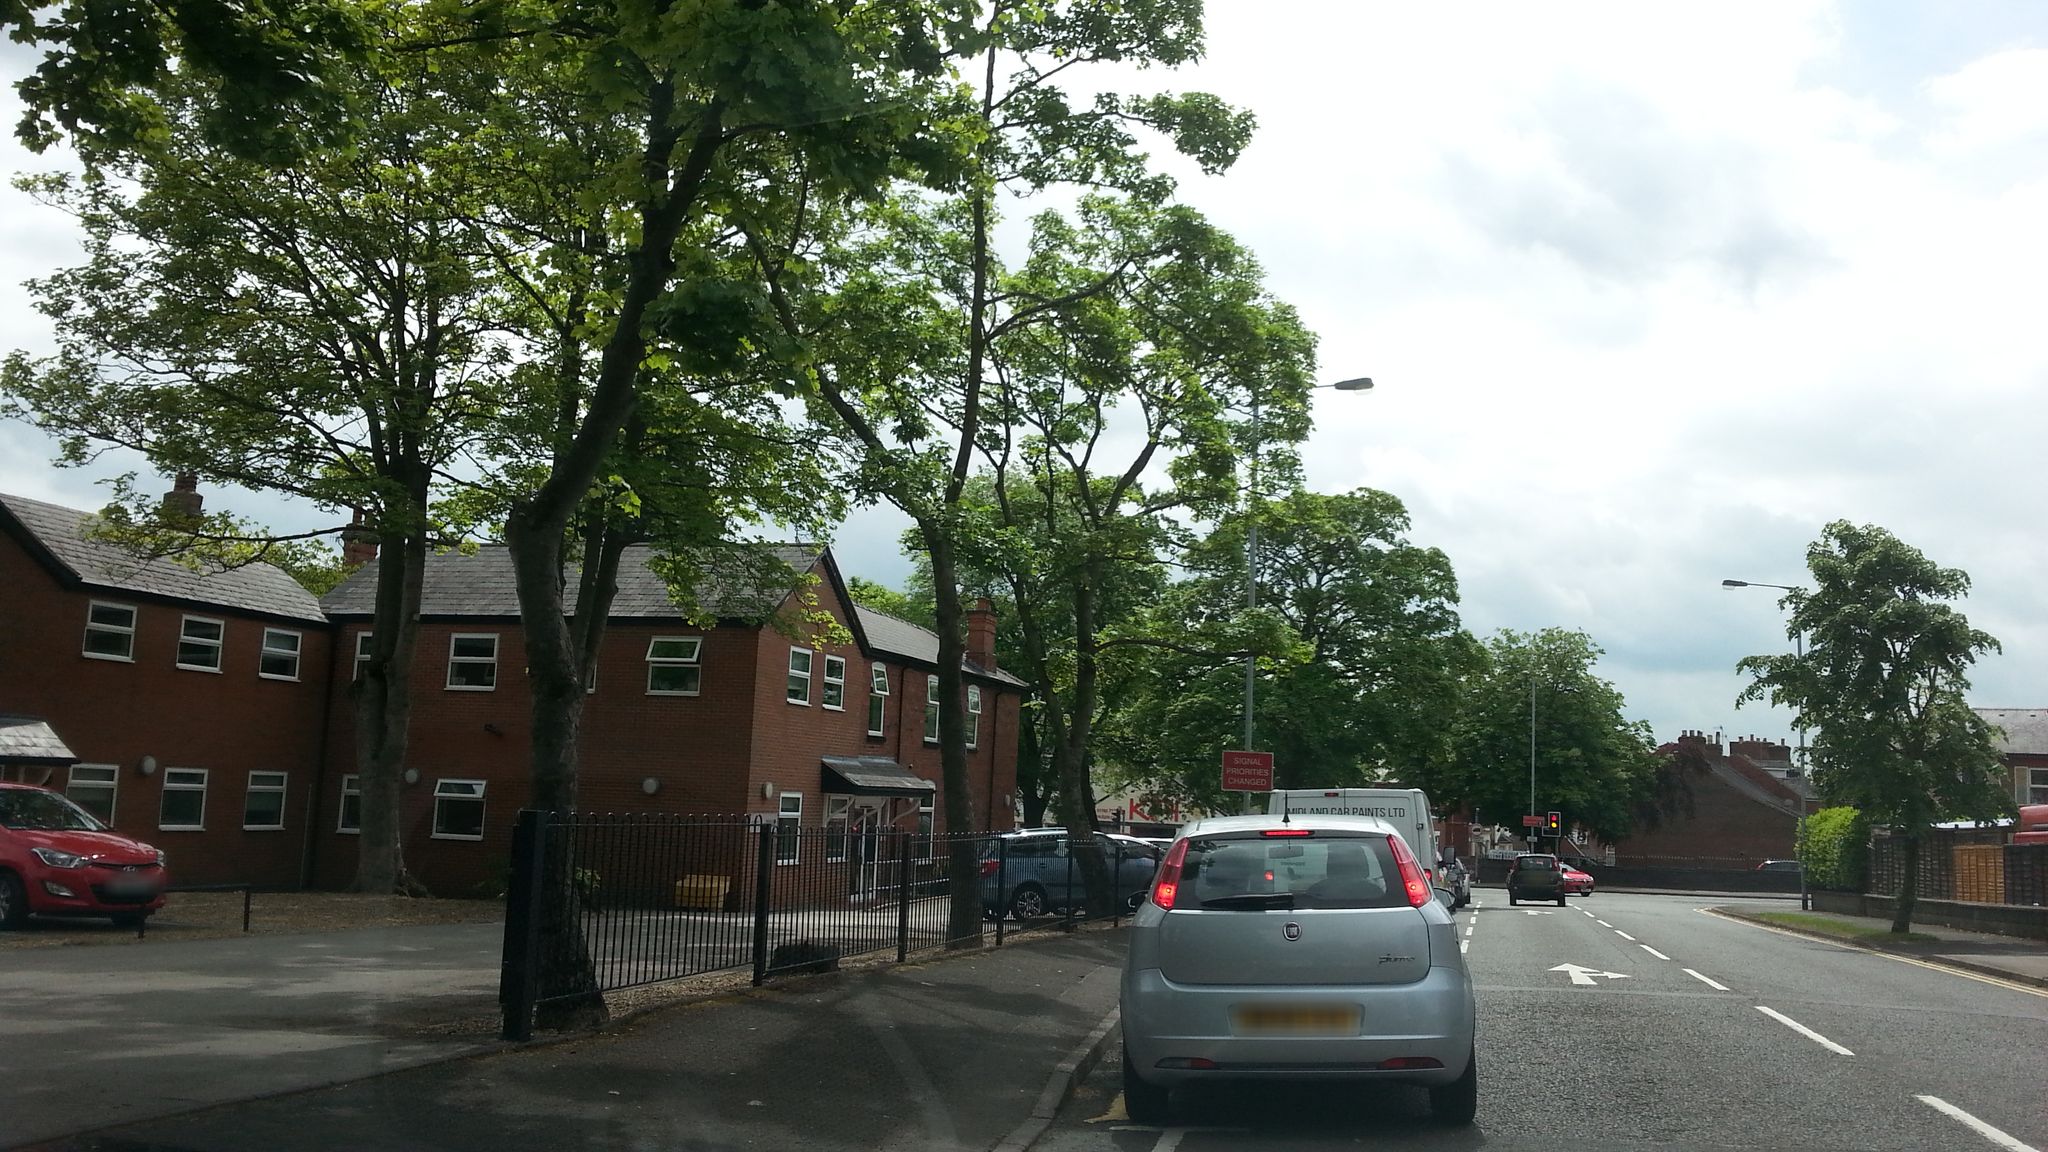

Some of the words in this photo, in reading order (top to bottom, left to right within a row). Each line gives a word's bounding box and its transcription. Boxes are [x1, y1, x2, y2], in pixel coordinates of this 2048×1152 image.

[1233, 757, 1264, 766] SIGNAL
[1226, 767, 1269, 777] PRIORITIES
[1228, 777, 1267, 786] CHANGED
[1330, 807, 1350, 816] CAR
[1352, 807, 1386, 818] PAINTS
[1388, 807, 1406, 818] LTD
